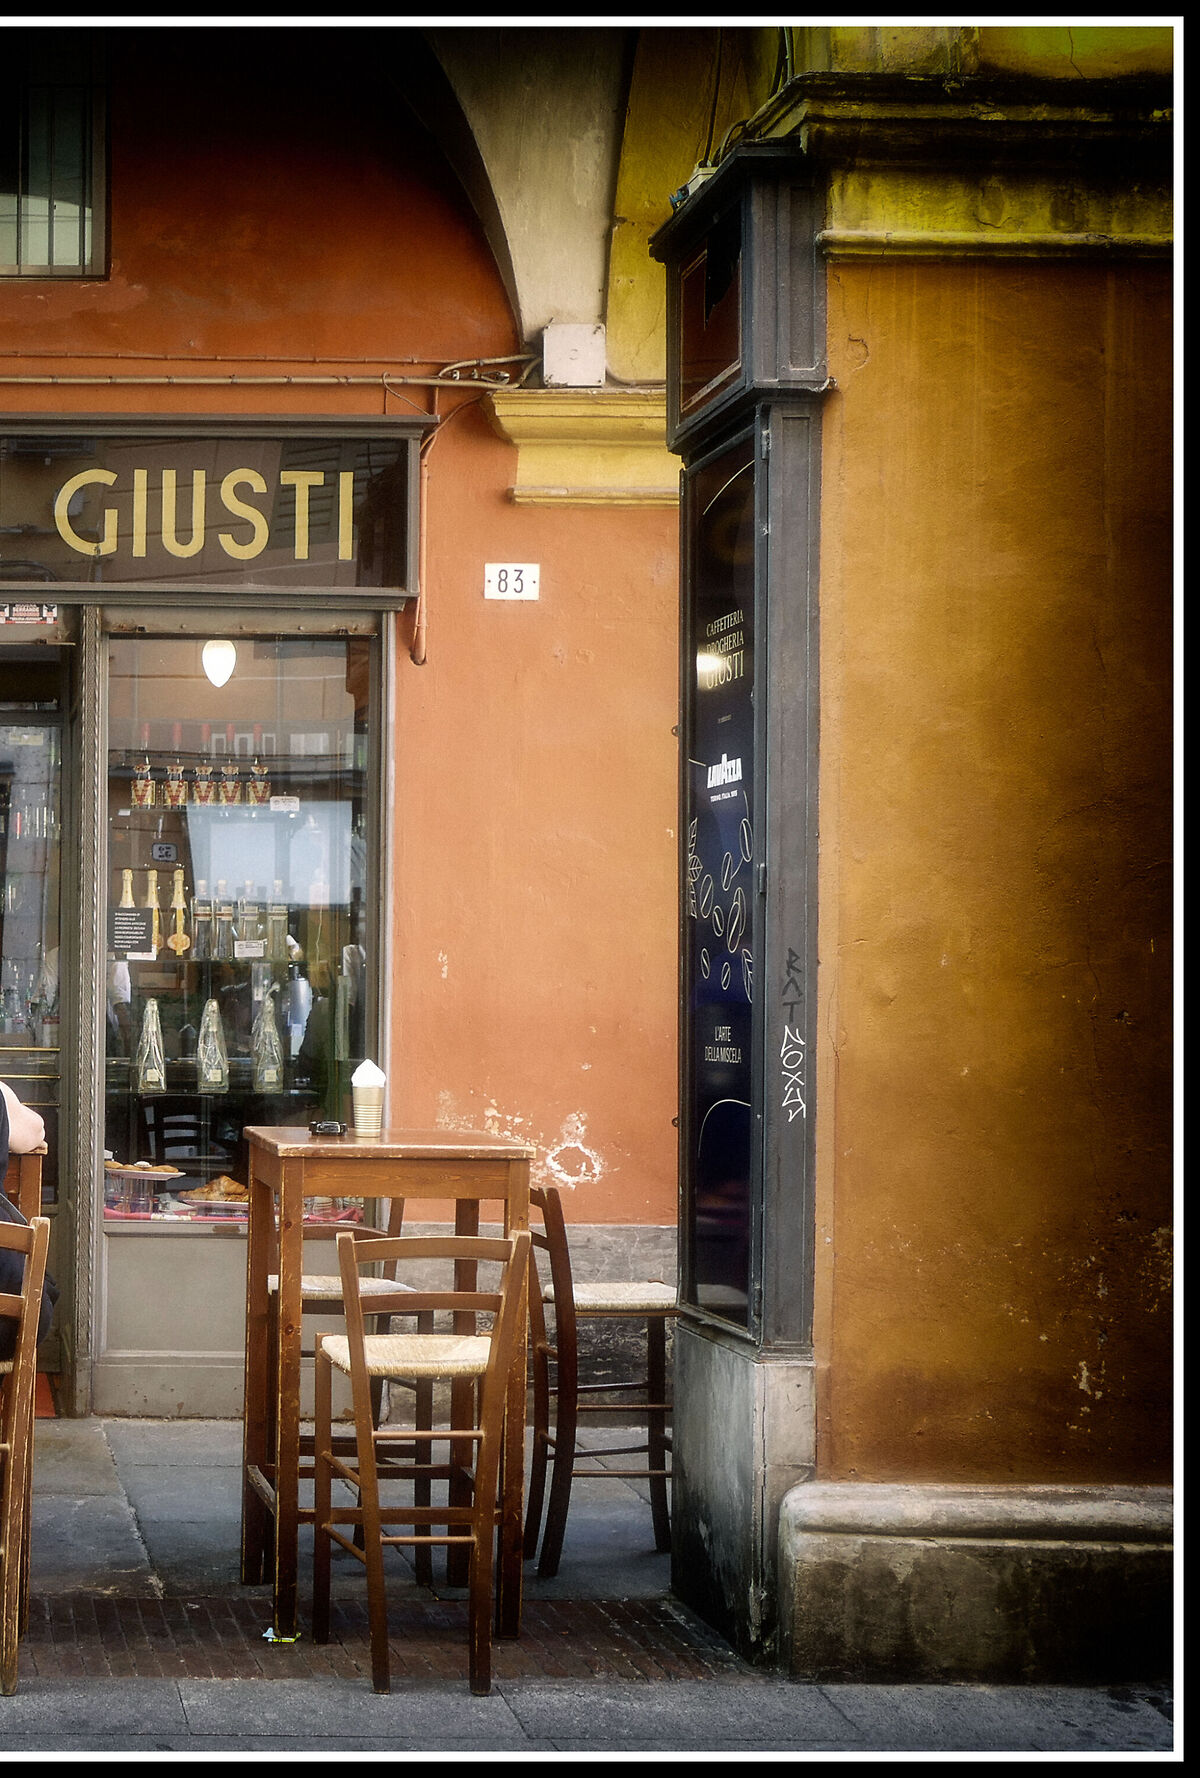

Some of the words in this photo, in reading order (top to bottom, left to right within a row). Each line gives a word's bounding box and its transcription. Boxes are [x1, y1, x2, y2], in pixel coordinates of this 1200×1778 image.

[53, 467, 354, 561] GIUSTI
[498, 568, 524, 593] 83
[706, 609, 744, 638] CAFFETTERIA
[706, 630, 745, 657] DROGHERIA
[707, 753, 743, 789] LAVAZZA
